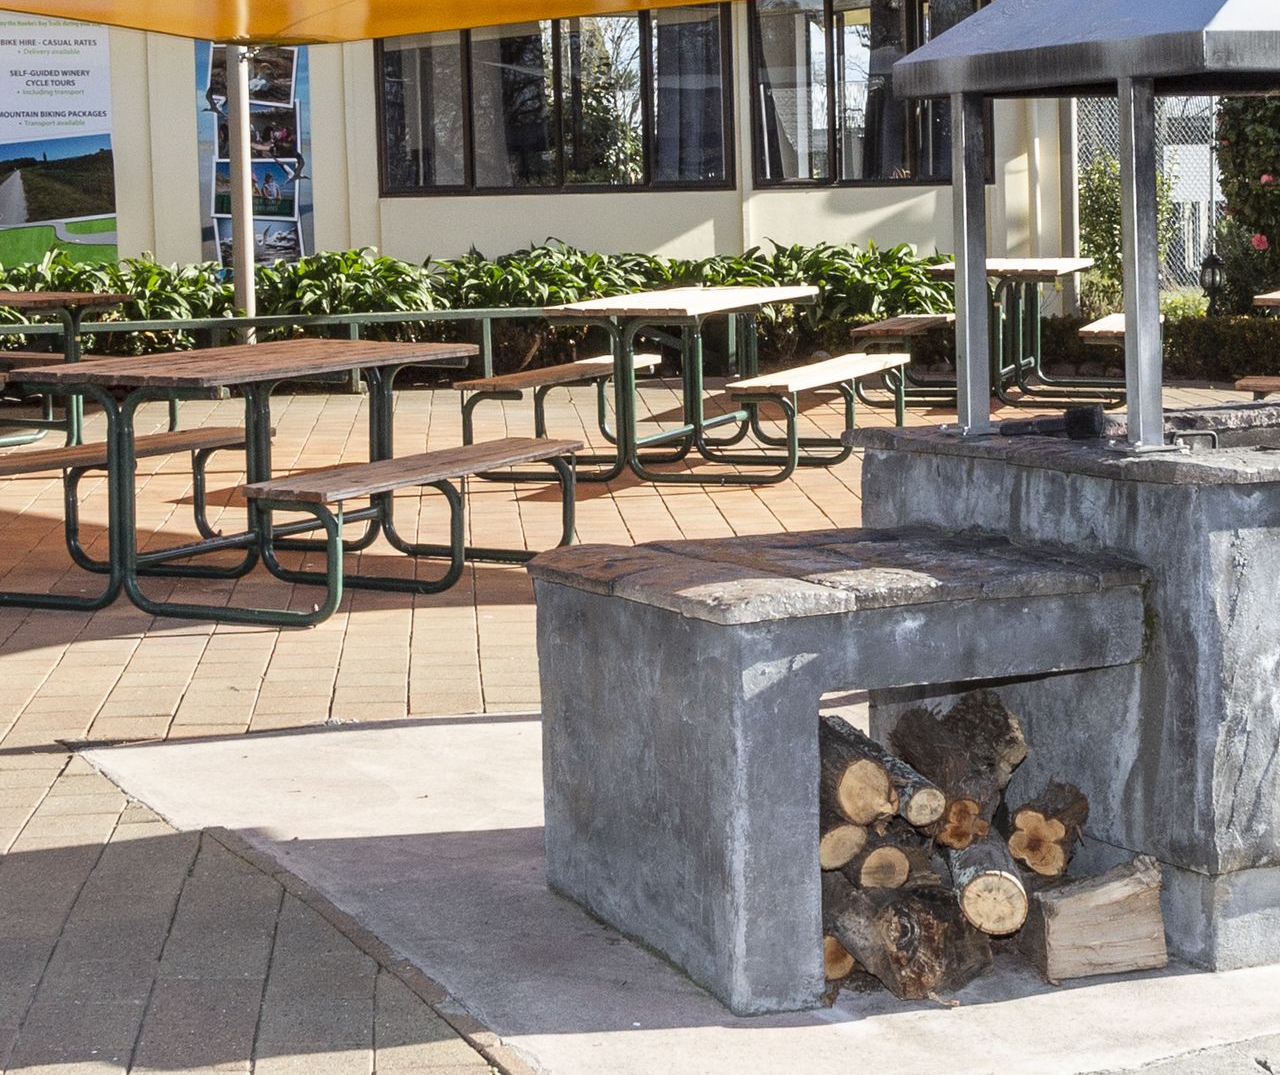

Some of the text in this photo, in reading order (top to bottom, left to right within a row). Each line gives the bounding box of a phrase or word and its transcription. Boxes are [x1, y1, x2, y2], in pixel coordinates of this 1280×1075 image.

[23, 48, 50, 56] Delivery
[9, 69, 90, 77] SELF-GUIDED WINERY
[25, 79, 76, 87] CYCLE TOURS
[68, 110, 107, 118] PACKAGES
